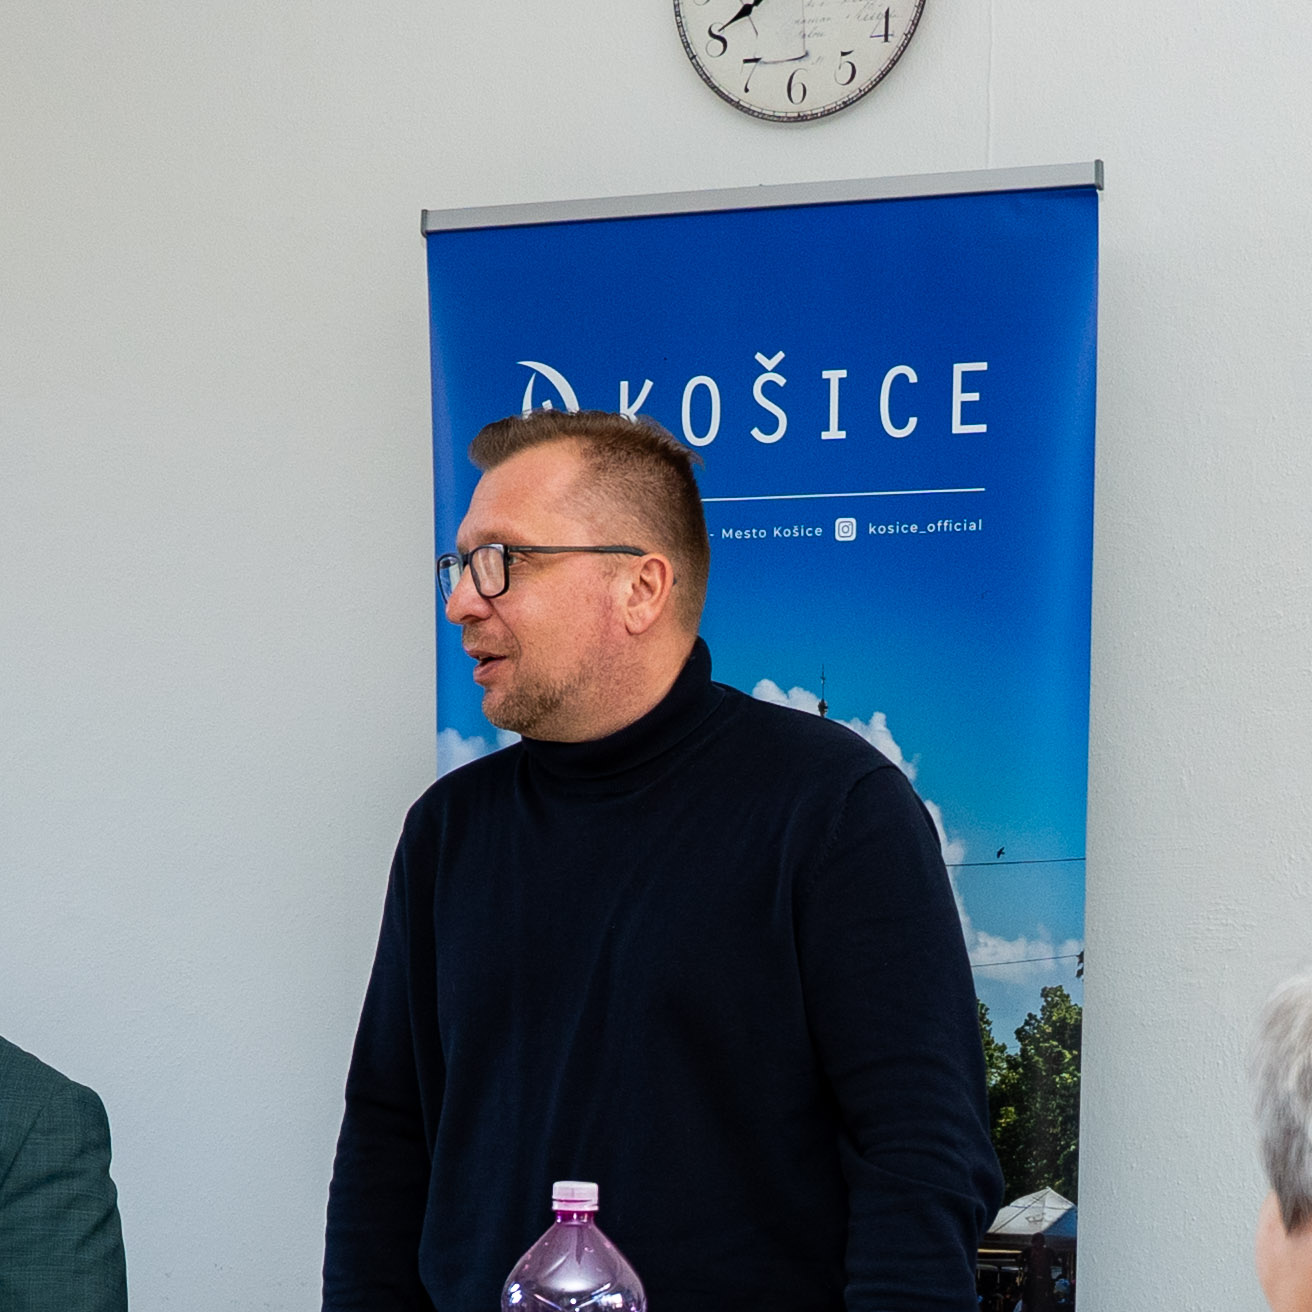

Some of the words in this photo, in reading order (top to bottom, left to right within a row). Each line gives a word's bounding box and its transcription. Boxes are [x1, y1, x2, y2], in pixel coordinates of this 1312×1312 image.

[705, 22, 728, 58] 8
[870, 7, 894, 43] 4
[741, 57, 762, 93] 7
[834, 50, 856, 86] 5
[787, 68, 808, 105] 6
[619, 350, 988, 447] KOŠICE
[721, 527, 767, 539] Mesto
[773, 525, 823, 538] Košice
[869, 518, 983, 535] kosice_official
